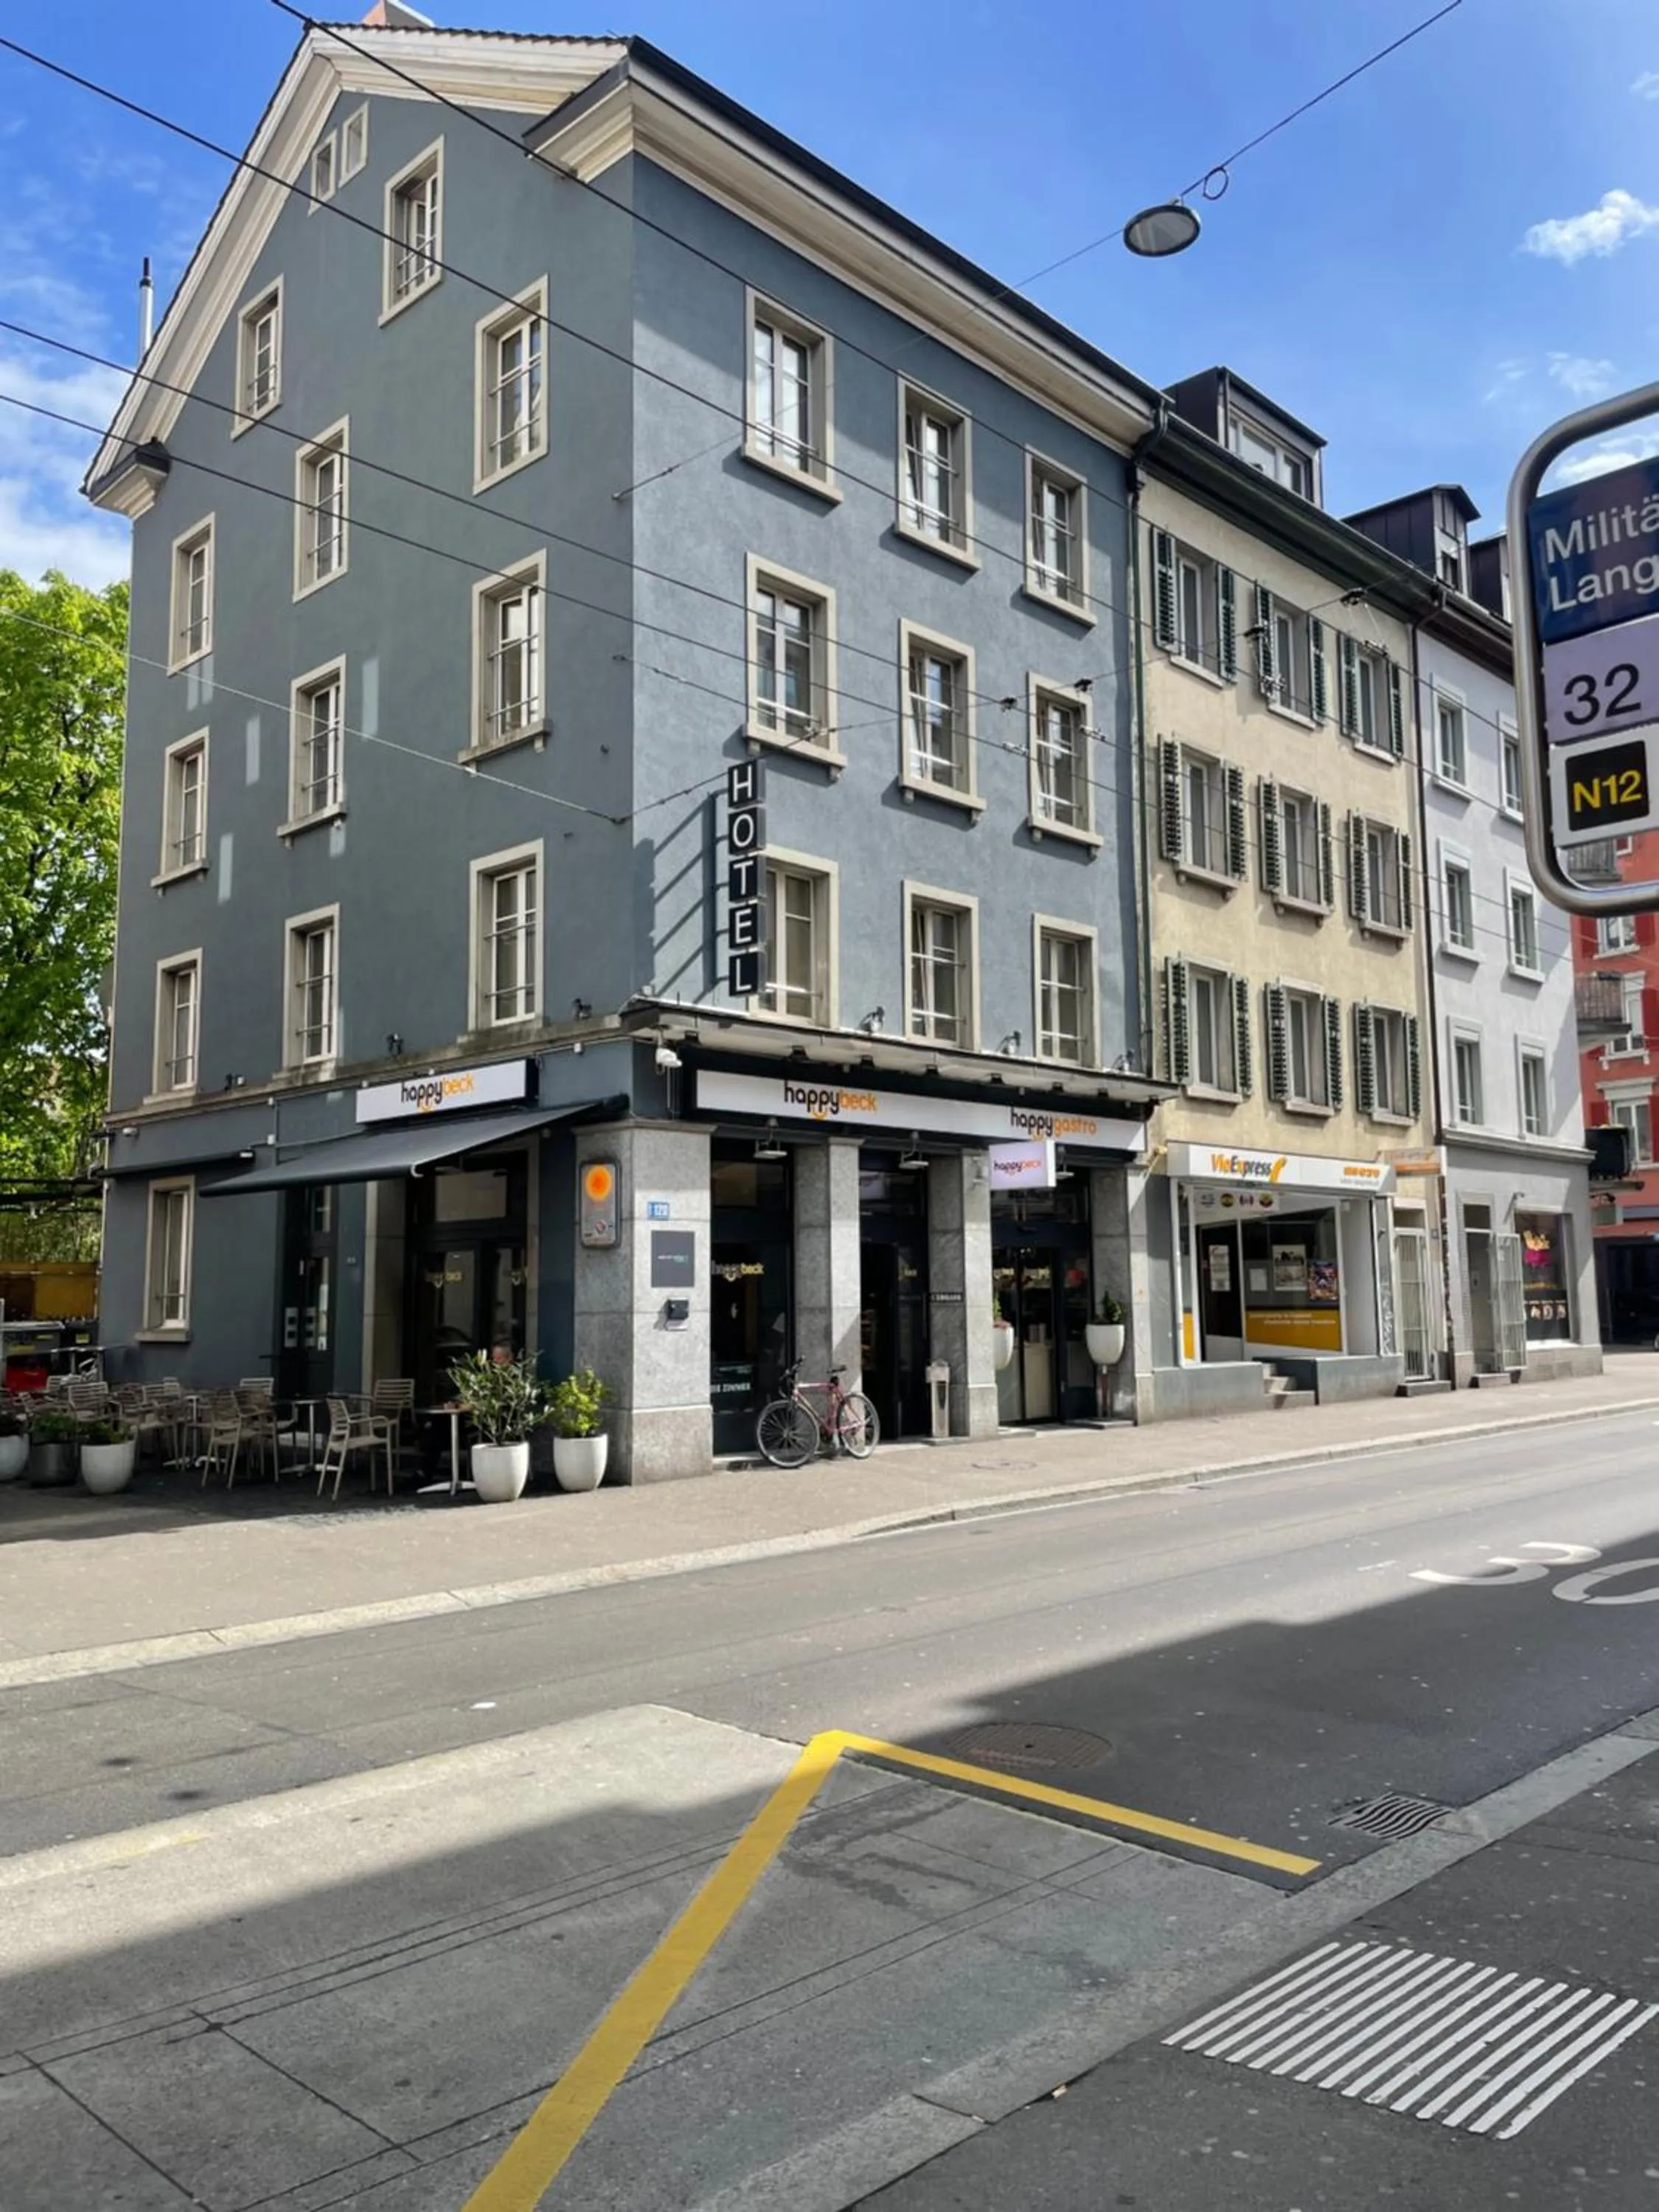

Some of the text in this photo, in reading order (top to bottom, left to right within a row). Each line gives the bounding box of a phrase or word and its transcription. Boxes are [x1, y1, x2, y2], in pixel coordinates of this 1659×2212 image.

[1545, 493, 1659, 564] Militä
[1550, 554, 1659, 612] Lang
[1564, 663, 1641, 726] 32
[1573, 770, 1642, 813] N12
[733, 765, 754, 992] HOTEL
[400, 1073, 474, 1112] happybeck
[784, 1079, 877, 1120] happybeck
[1010, 1106, 1097, 1141] happygastro
[993, 1159, 1041, 1175] happybeck
